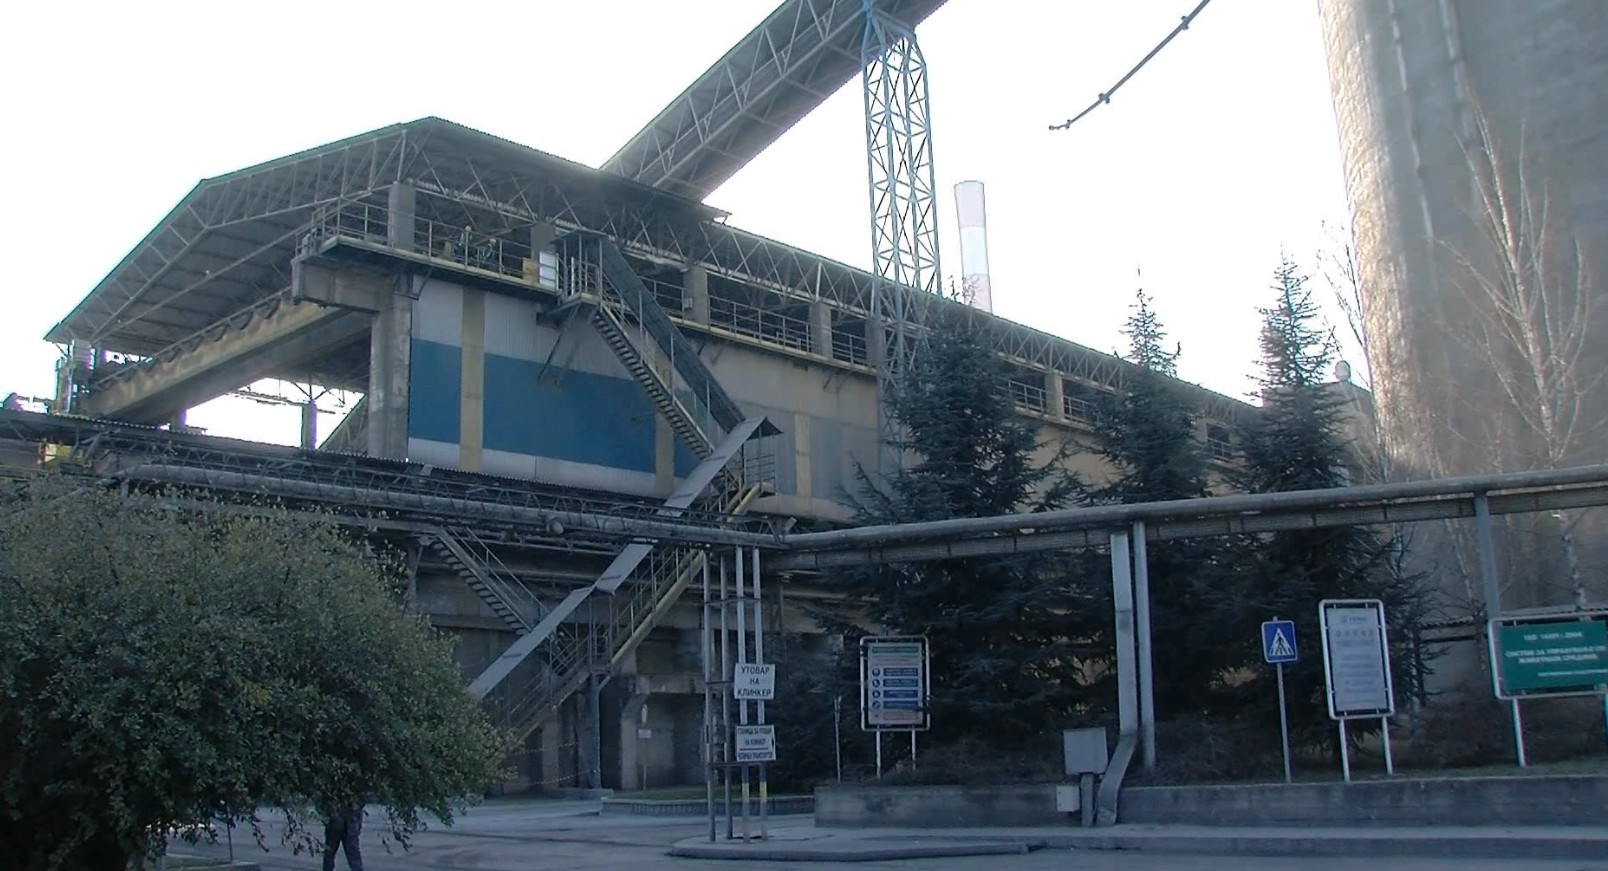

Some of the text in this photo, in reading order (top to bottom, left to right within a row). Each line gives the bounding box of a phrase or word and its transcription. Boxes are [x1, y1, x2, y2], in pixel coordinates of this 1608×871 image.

[741, 666, 770, 675] УТОВАР
[749, 677, 760, 685] НА
[737, 688, 772, 697] КЛИНКЕР
